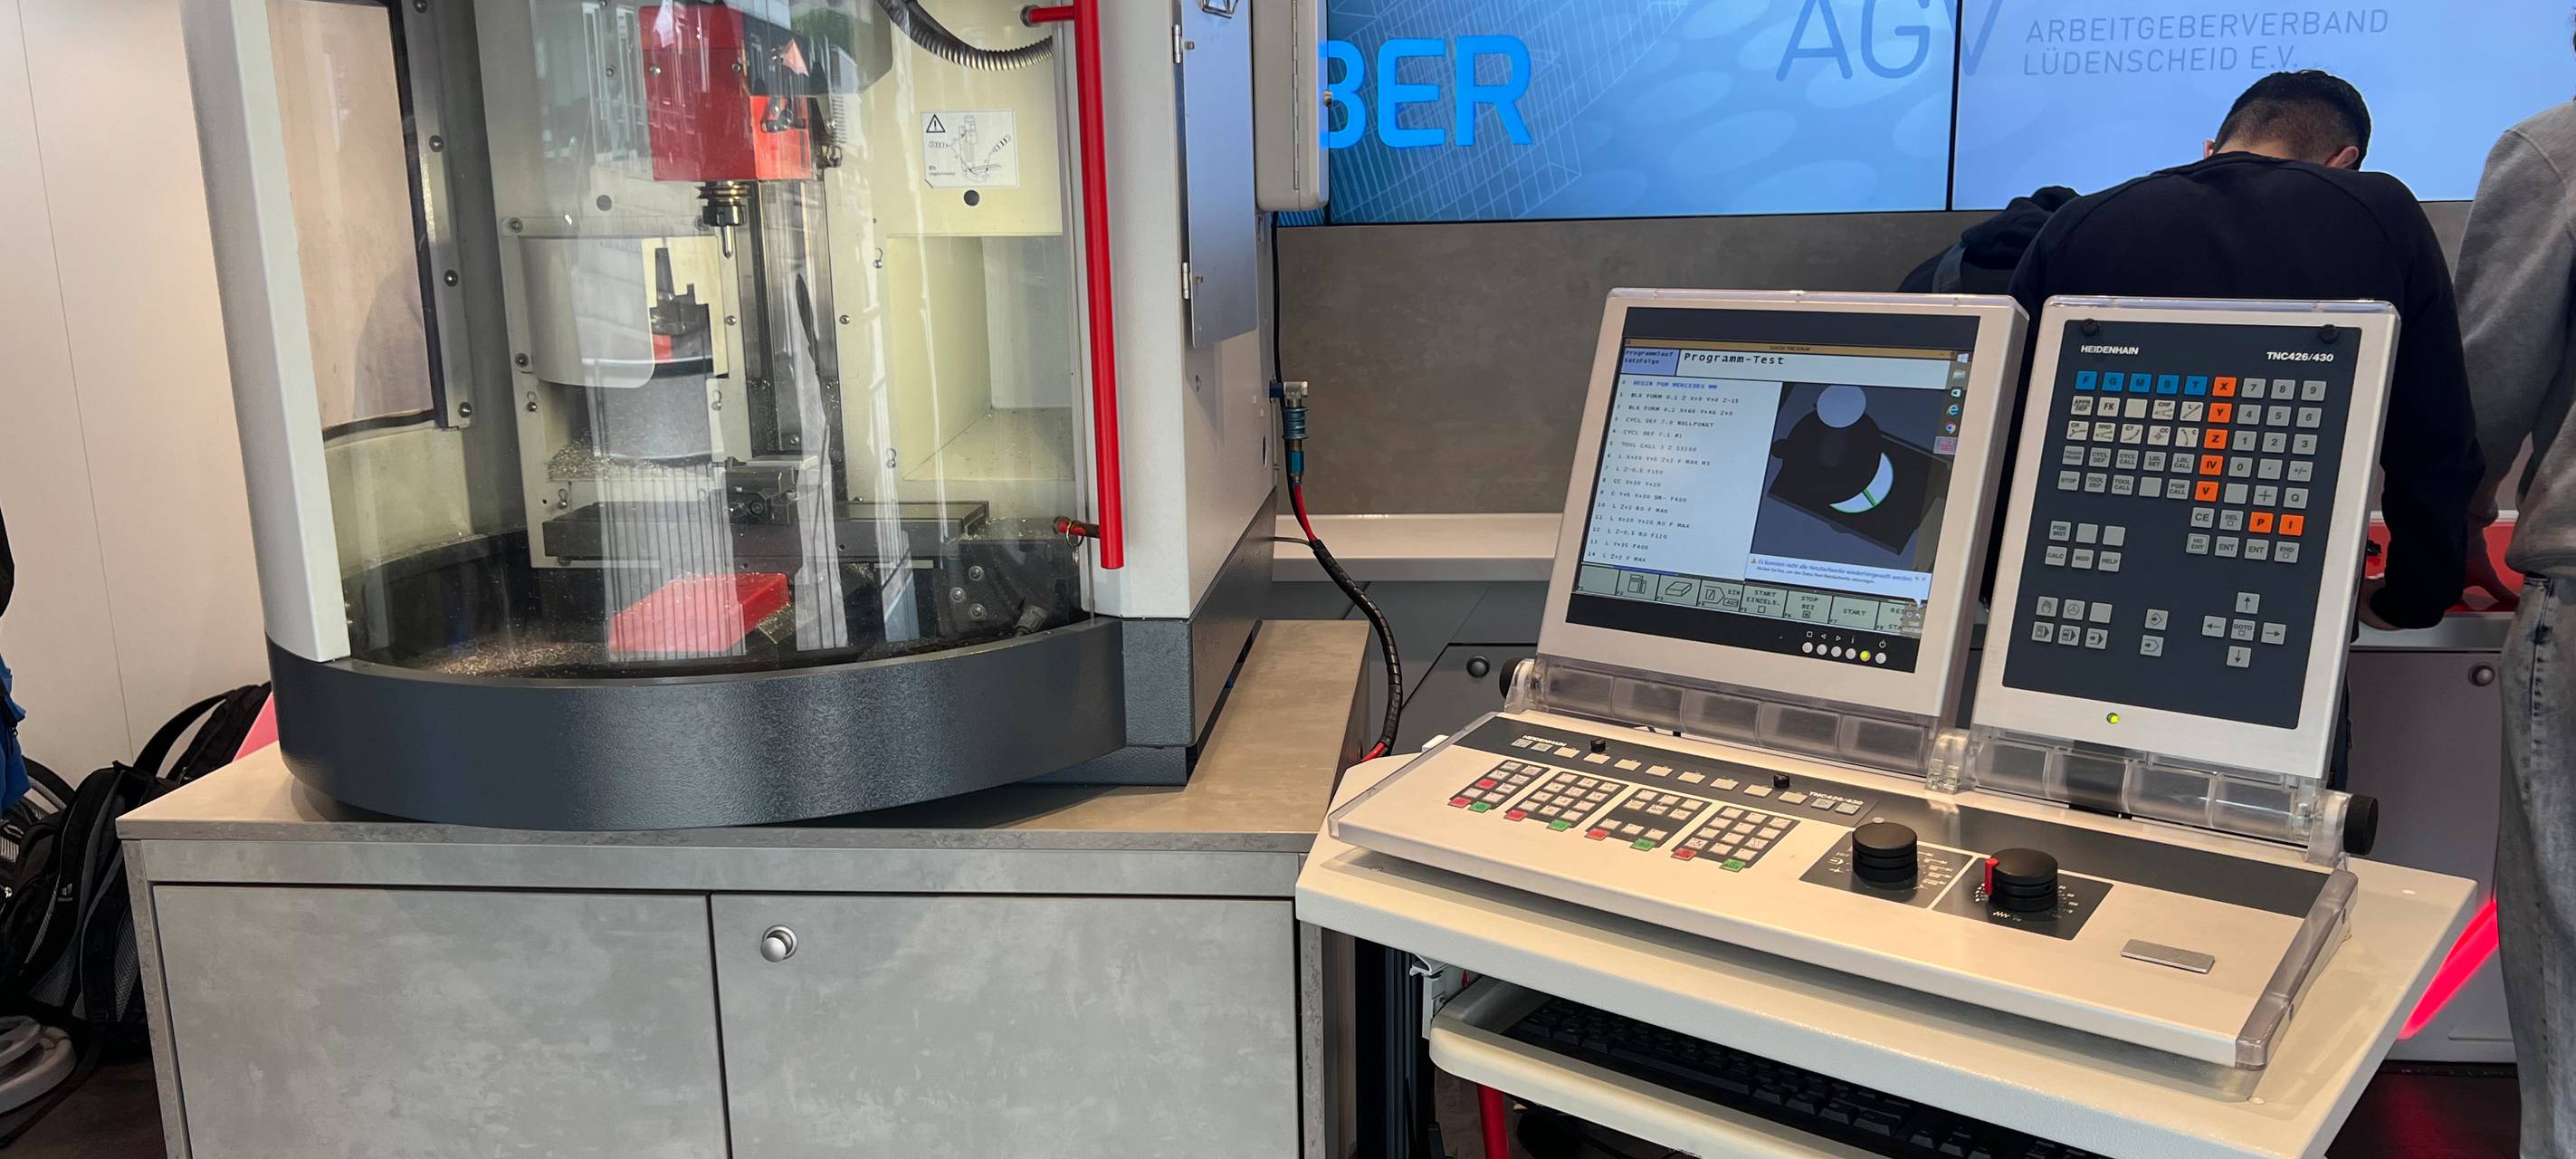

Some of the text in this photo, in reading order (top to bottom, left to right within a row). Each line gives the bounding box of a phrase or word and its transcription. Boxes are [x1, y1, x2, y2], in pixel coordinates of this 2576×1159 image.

[2026, 9, 2389, 43] ARBEITGEBERVERBAND
[1775, 0, 2003, 81] AGV
[2024, 44, 2299, 76] LÜDENSCHEID E.V.
[2081, 345, 2139, 355] HEIDENHAIN
[1684, 352, 1785, 365] Programm-Test
[2266, 351, 2334, 362] TNC426/430
[2192, 381, 2199, 389] T
[2219, 382, 2228, 390] X
[2250, 384, 2257, 392] 7
[2279, 385, 2286, 393] 8
[2310, 386, 2317, 395] 9
[2104, 402, 2114, 410] FK
[2217, 408, 2224, 417] Y
[2246, 410, 2252, 418] 4
[2275, 412, 2282, 420] 5
[2305, 413, 2313, 422] 6
[2211, 435, 2220, 443] Z
[2271, 438, 2278, 446] 2
[2302, 440, 2309, 448] 3
[2206, 461, 2218, 469] IV
[2291, 493, 2299, 502] Q
[2194, 512, 2209, 522] CE
[2256, 518, 2265, 526] P
[2248, 545, 2265, 553] ENT
